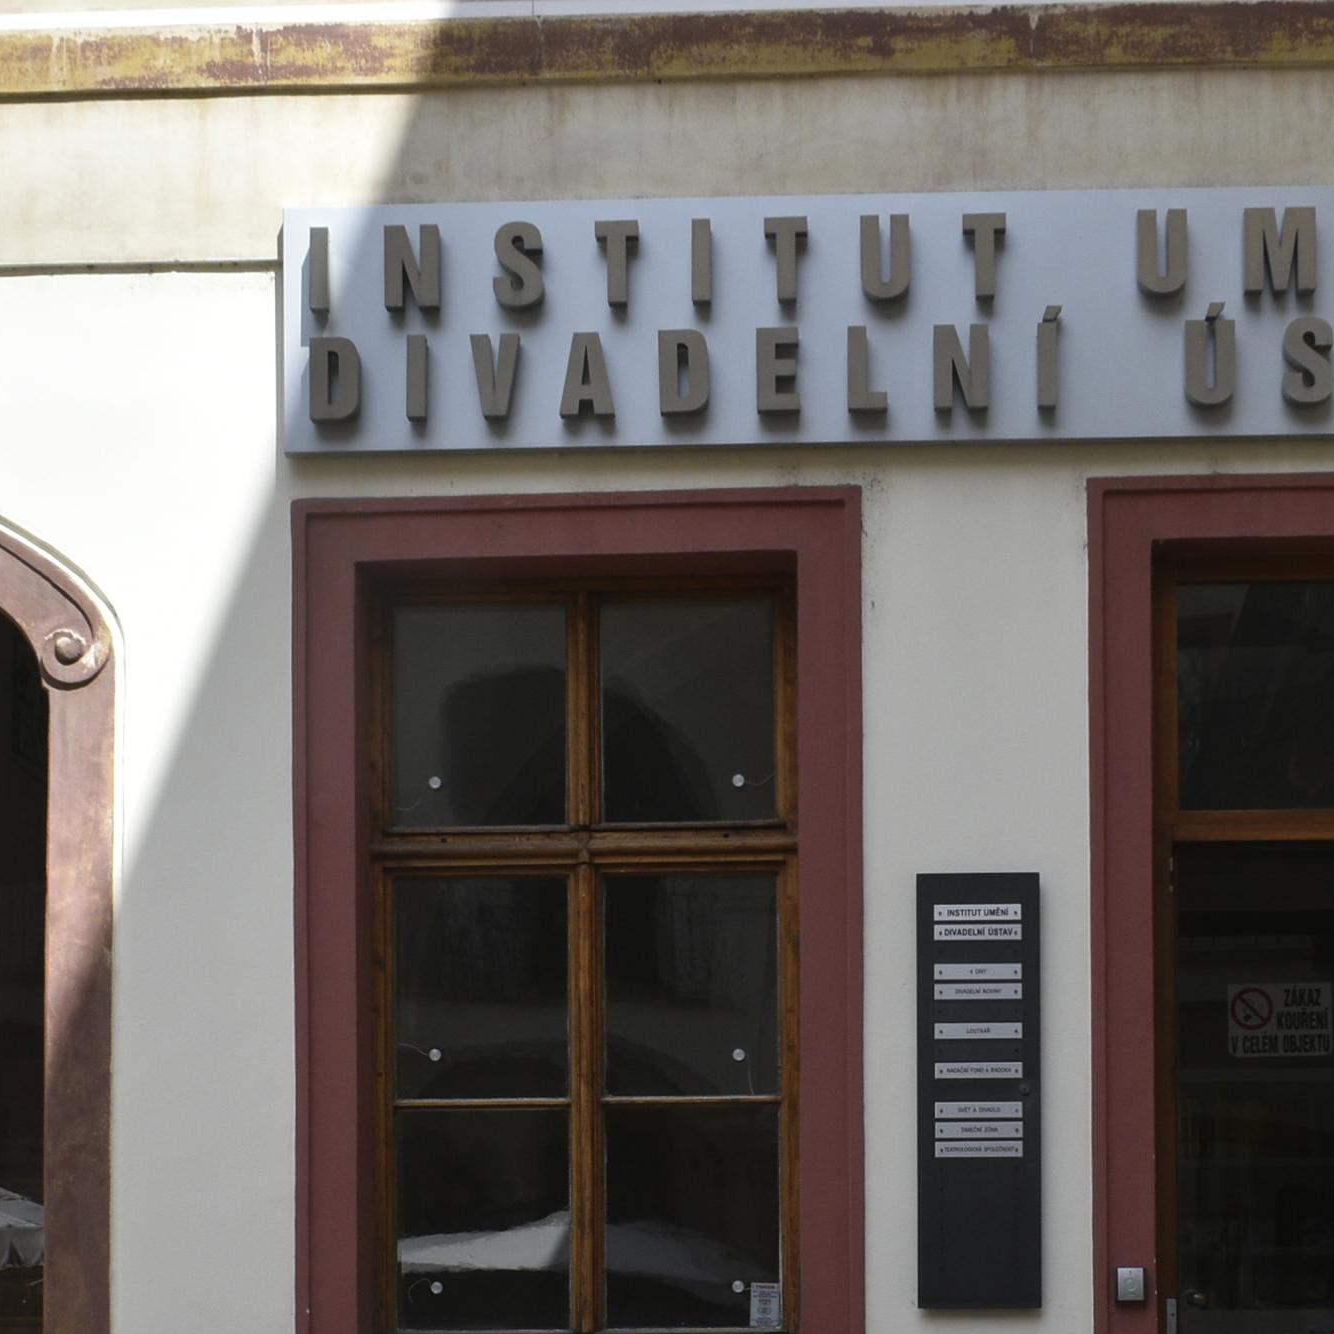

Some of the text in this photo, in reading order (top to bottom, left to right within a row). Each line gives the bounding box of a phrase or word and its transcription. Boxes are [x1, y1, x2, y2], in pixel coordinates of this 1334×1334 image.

[309, 212, 1007, 313] INSTITUT
[309, 305, 1063, 422] DIVADELNÍ
[947, 906, 1009, 917] INSTITUT UMĚNÍ
[944, 926, 1013, 937] DIVADELNÍ ÚSTAV
[1283, 984, 1321, 1007] ZÁKAZ
[1276, 1007, 1328, 1030] KOUŘENÍ
[1231, 1031, 1330, 1054] V CELÉM OBJEKTU
